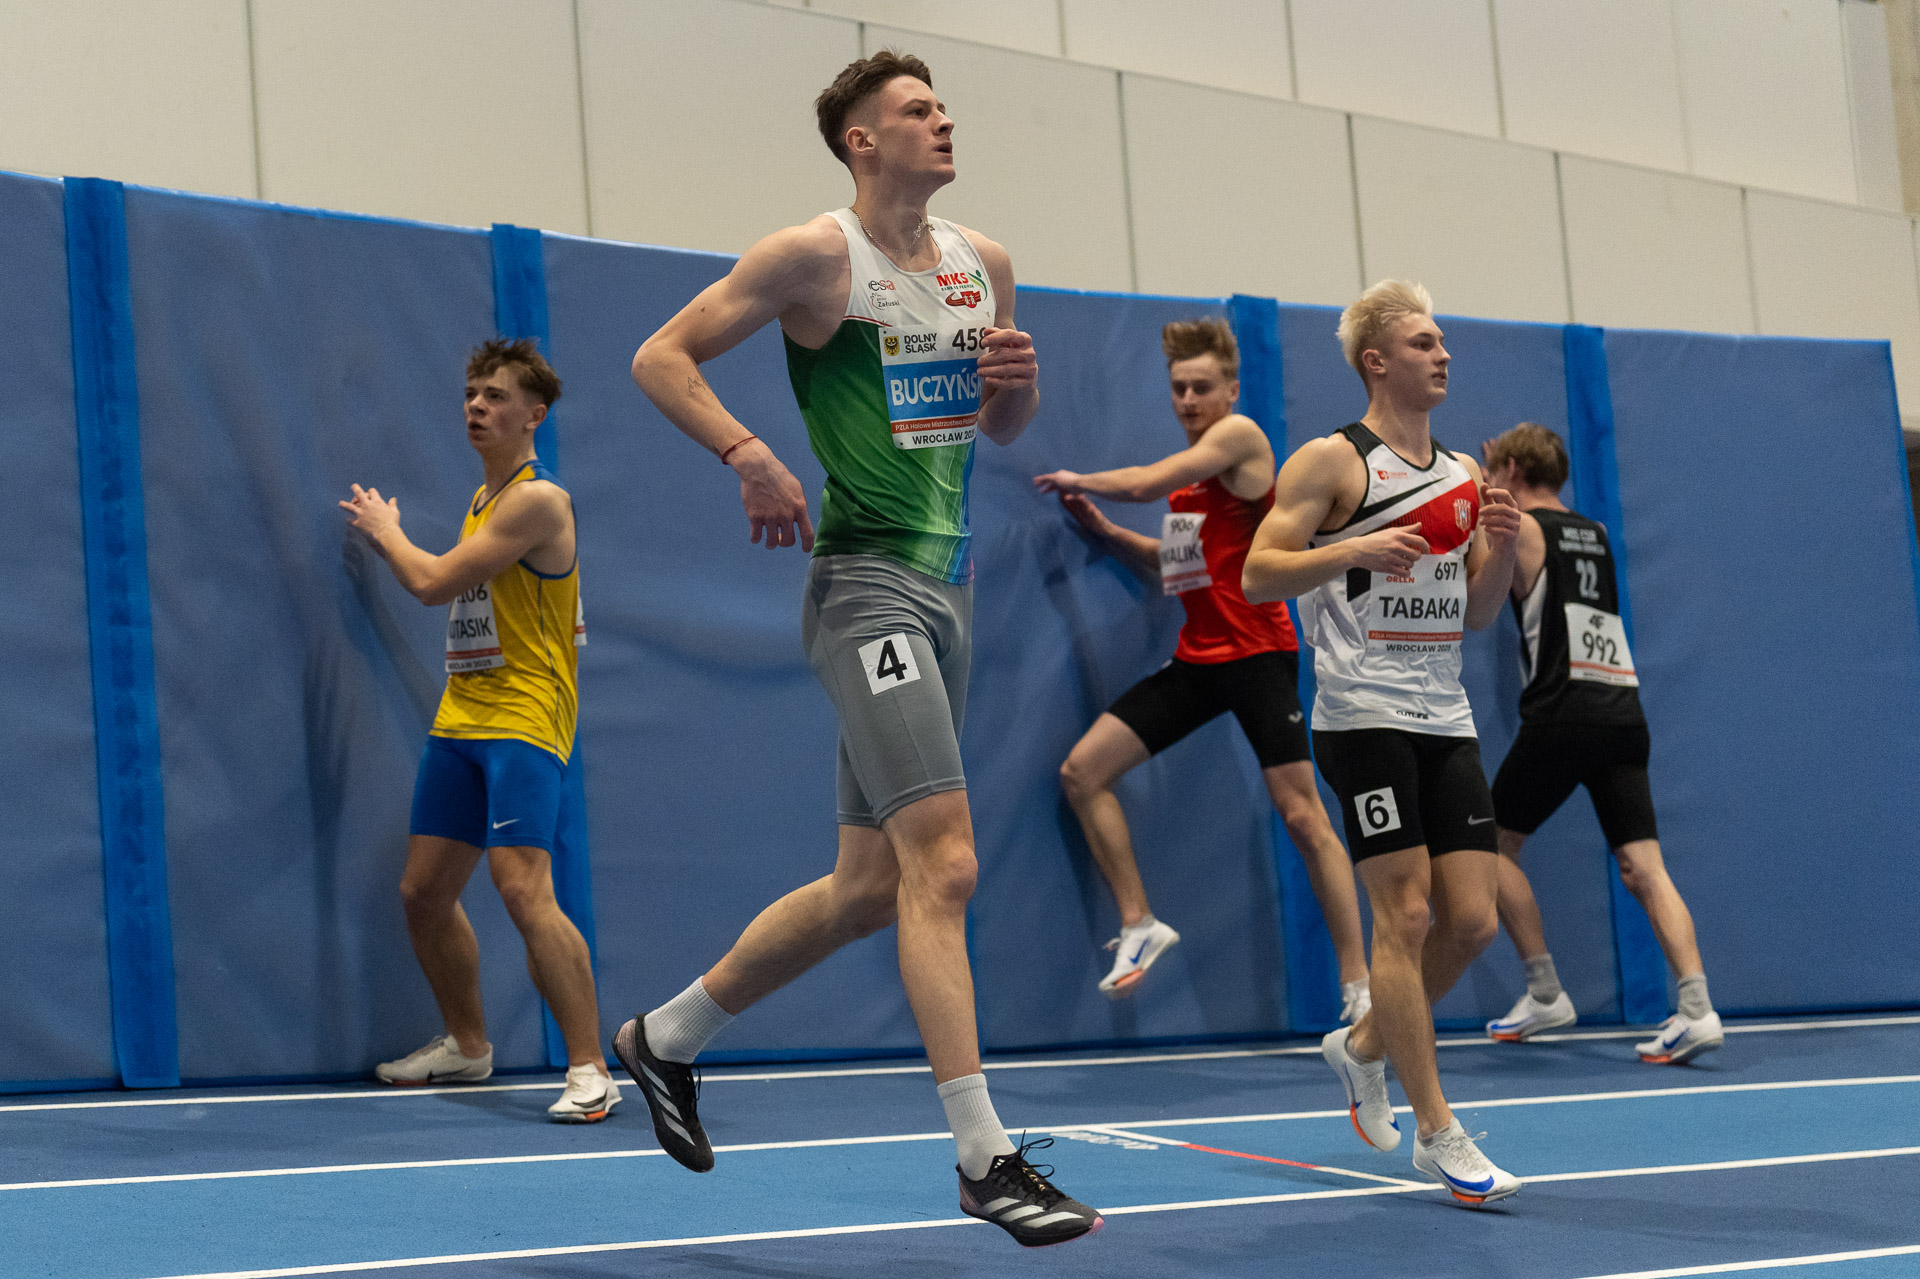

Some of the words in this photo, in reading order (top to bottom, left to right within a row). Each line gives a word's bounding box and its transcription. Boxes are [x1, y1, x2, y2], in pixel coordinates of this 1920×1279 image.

[936, 272, 969, 287] MKS
[904, 333, 937, 344] DOLNY
[912, 431, 963, 445] WROCŁAW
[1434, 561, 1458, 581] 697
[1575, 558, 1600, 600] 22
[456, 583, 488, 603] 106
[1378, 596, 1460, 619] TABAKA
[1386, 643, 1437, 652] WROCŁAW
[1582, 631, 1621, 666] 992
[876, 639, 908, 681] 4
[1364, 793, 1390, 830] 6
